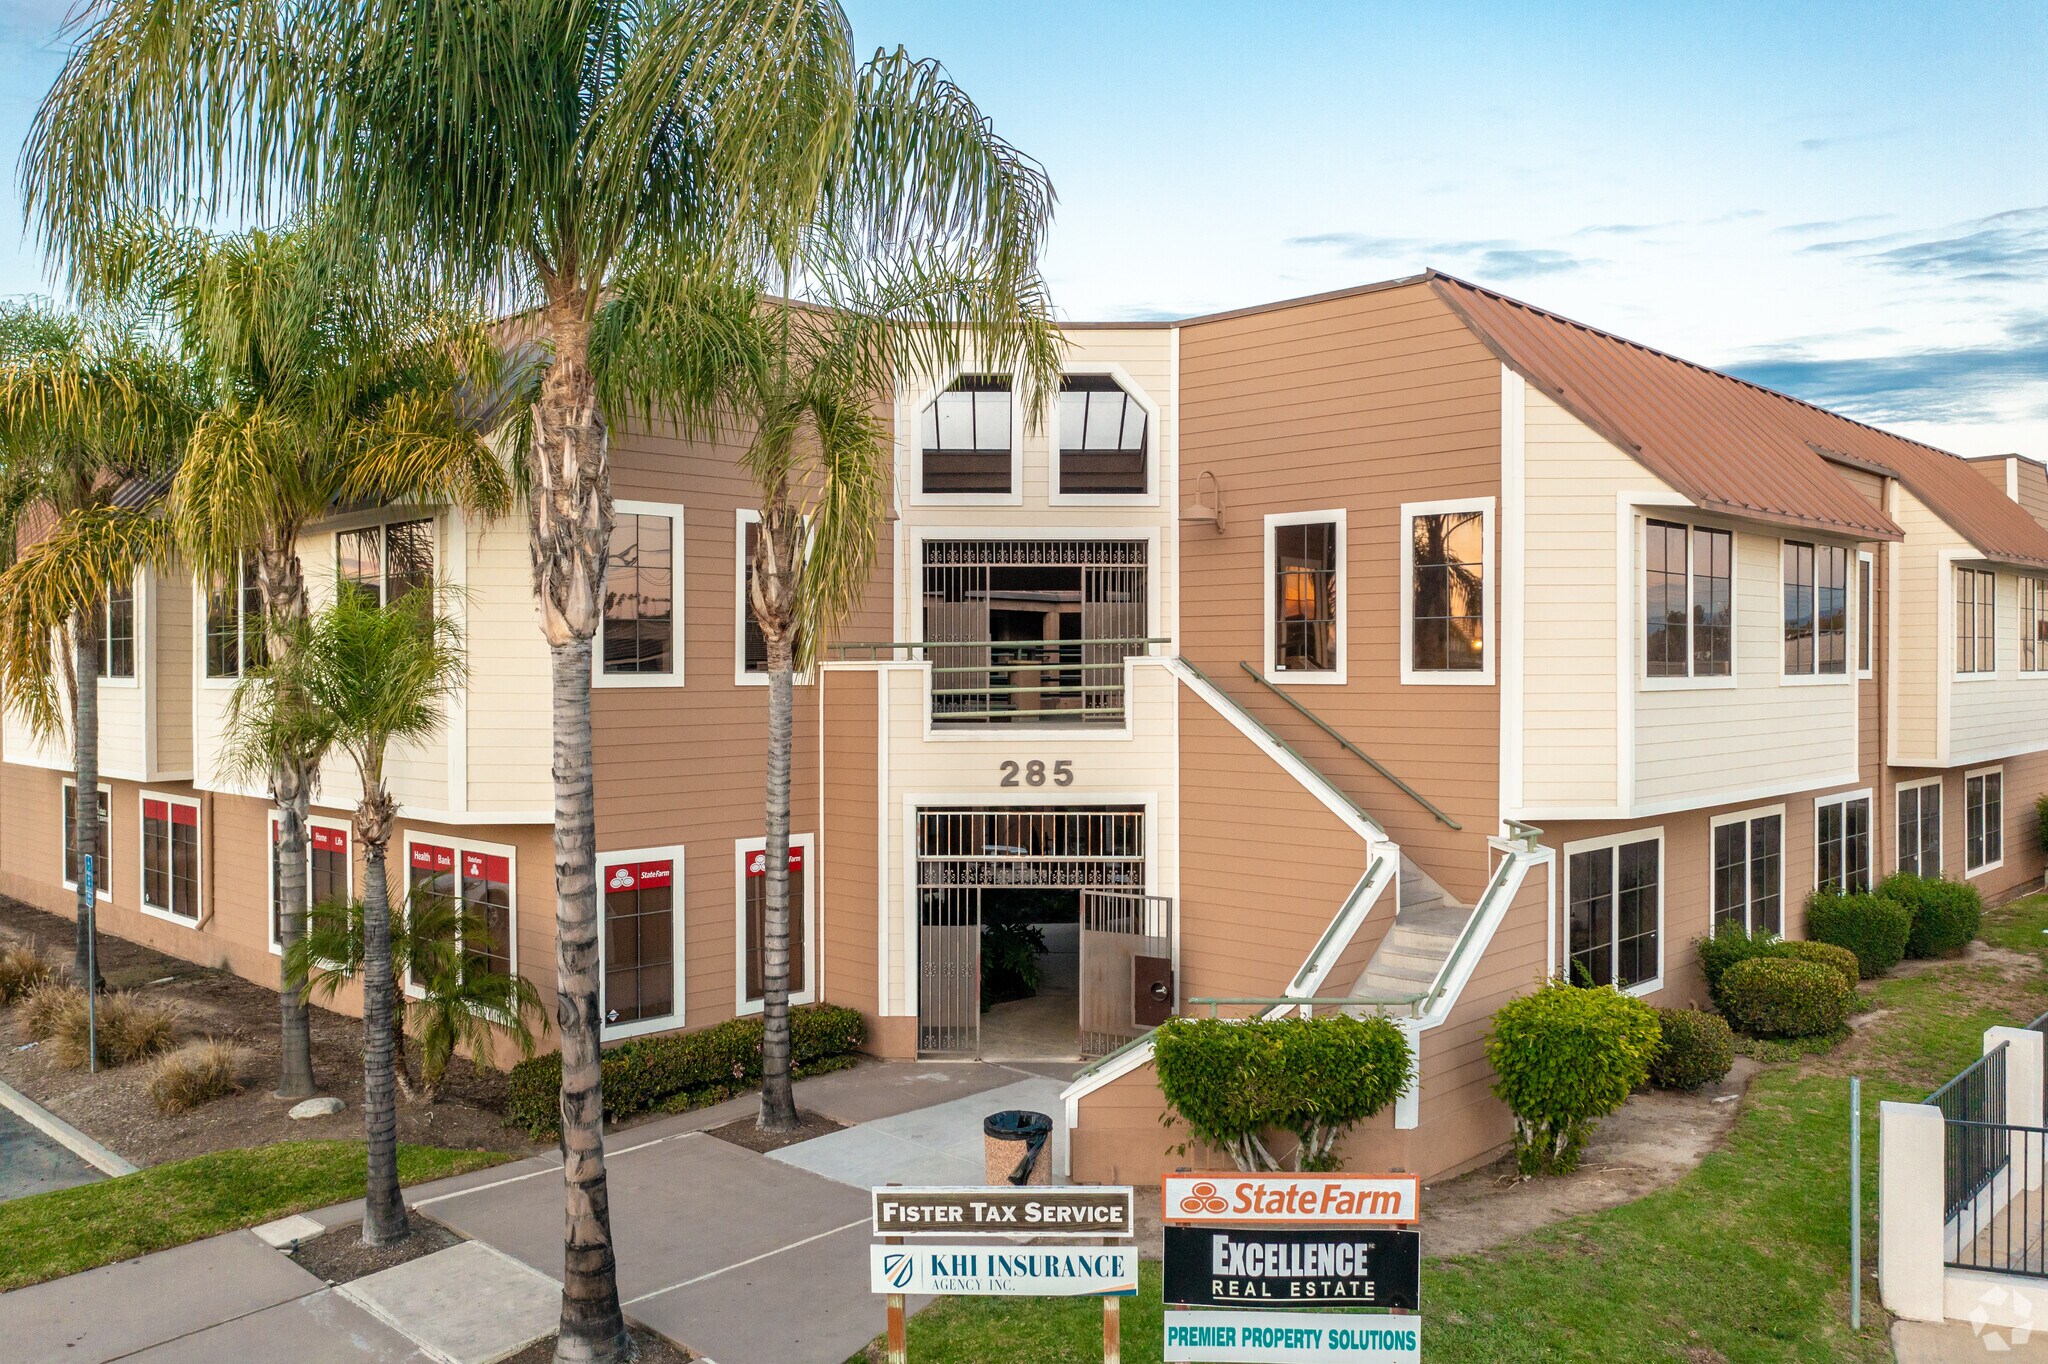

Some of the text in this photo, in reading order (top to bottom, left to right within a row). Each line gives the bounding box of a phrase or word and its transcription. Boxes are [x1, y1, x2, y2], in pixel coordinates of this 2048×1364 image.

[1000, 760, 1074, 787] 285
[315, 832, 328, 843] Home
[334, 837, 344, 846] Life
[414, 851, 431, 862] Health
[437, 854, 451, 866] Bank
[883, 1202, 1123, 1223] FISTER TAX SERVICE
[1212, 1234, 1368, 1277] EXCELLENCE
[931, 1254, 1124, 1278] KHI INSURANCE
[931, 1279, 1016, 1291] AGENCY INC.
[1212, 1280, 1375, 1296] REAL ESTATE
[1168, 1326, 1417, 1351] PREMIER PROPERTY SOLUTIONS
